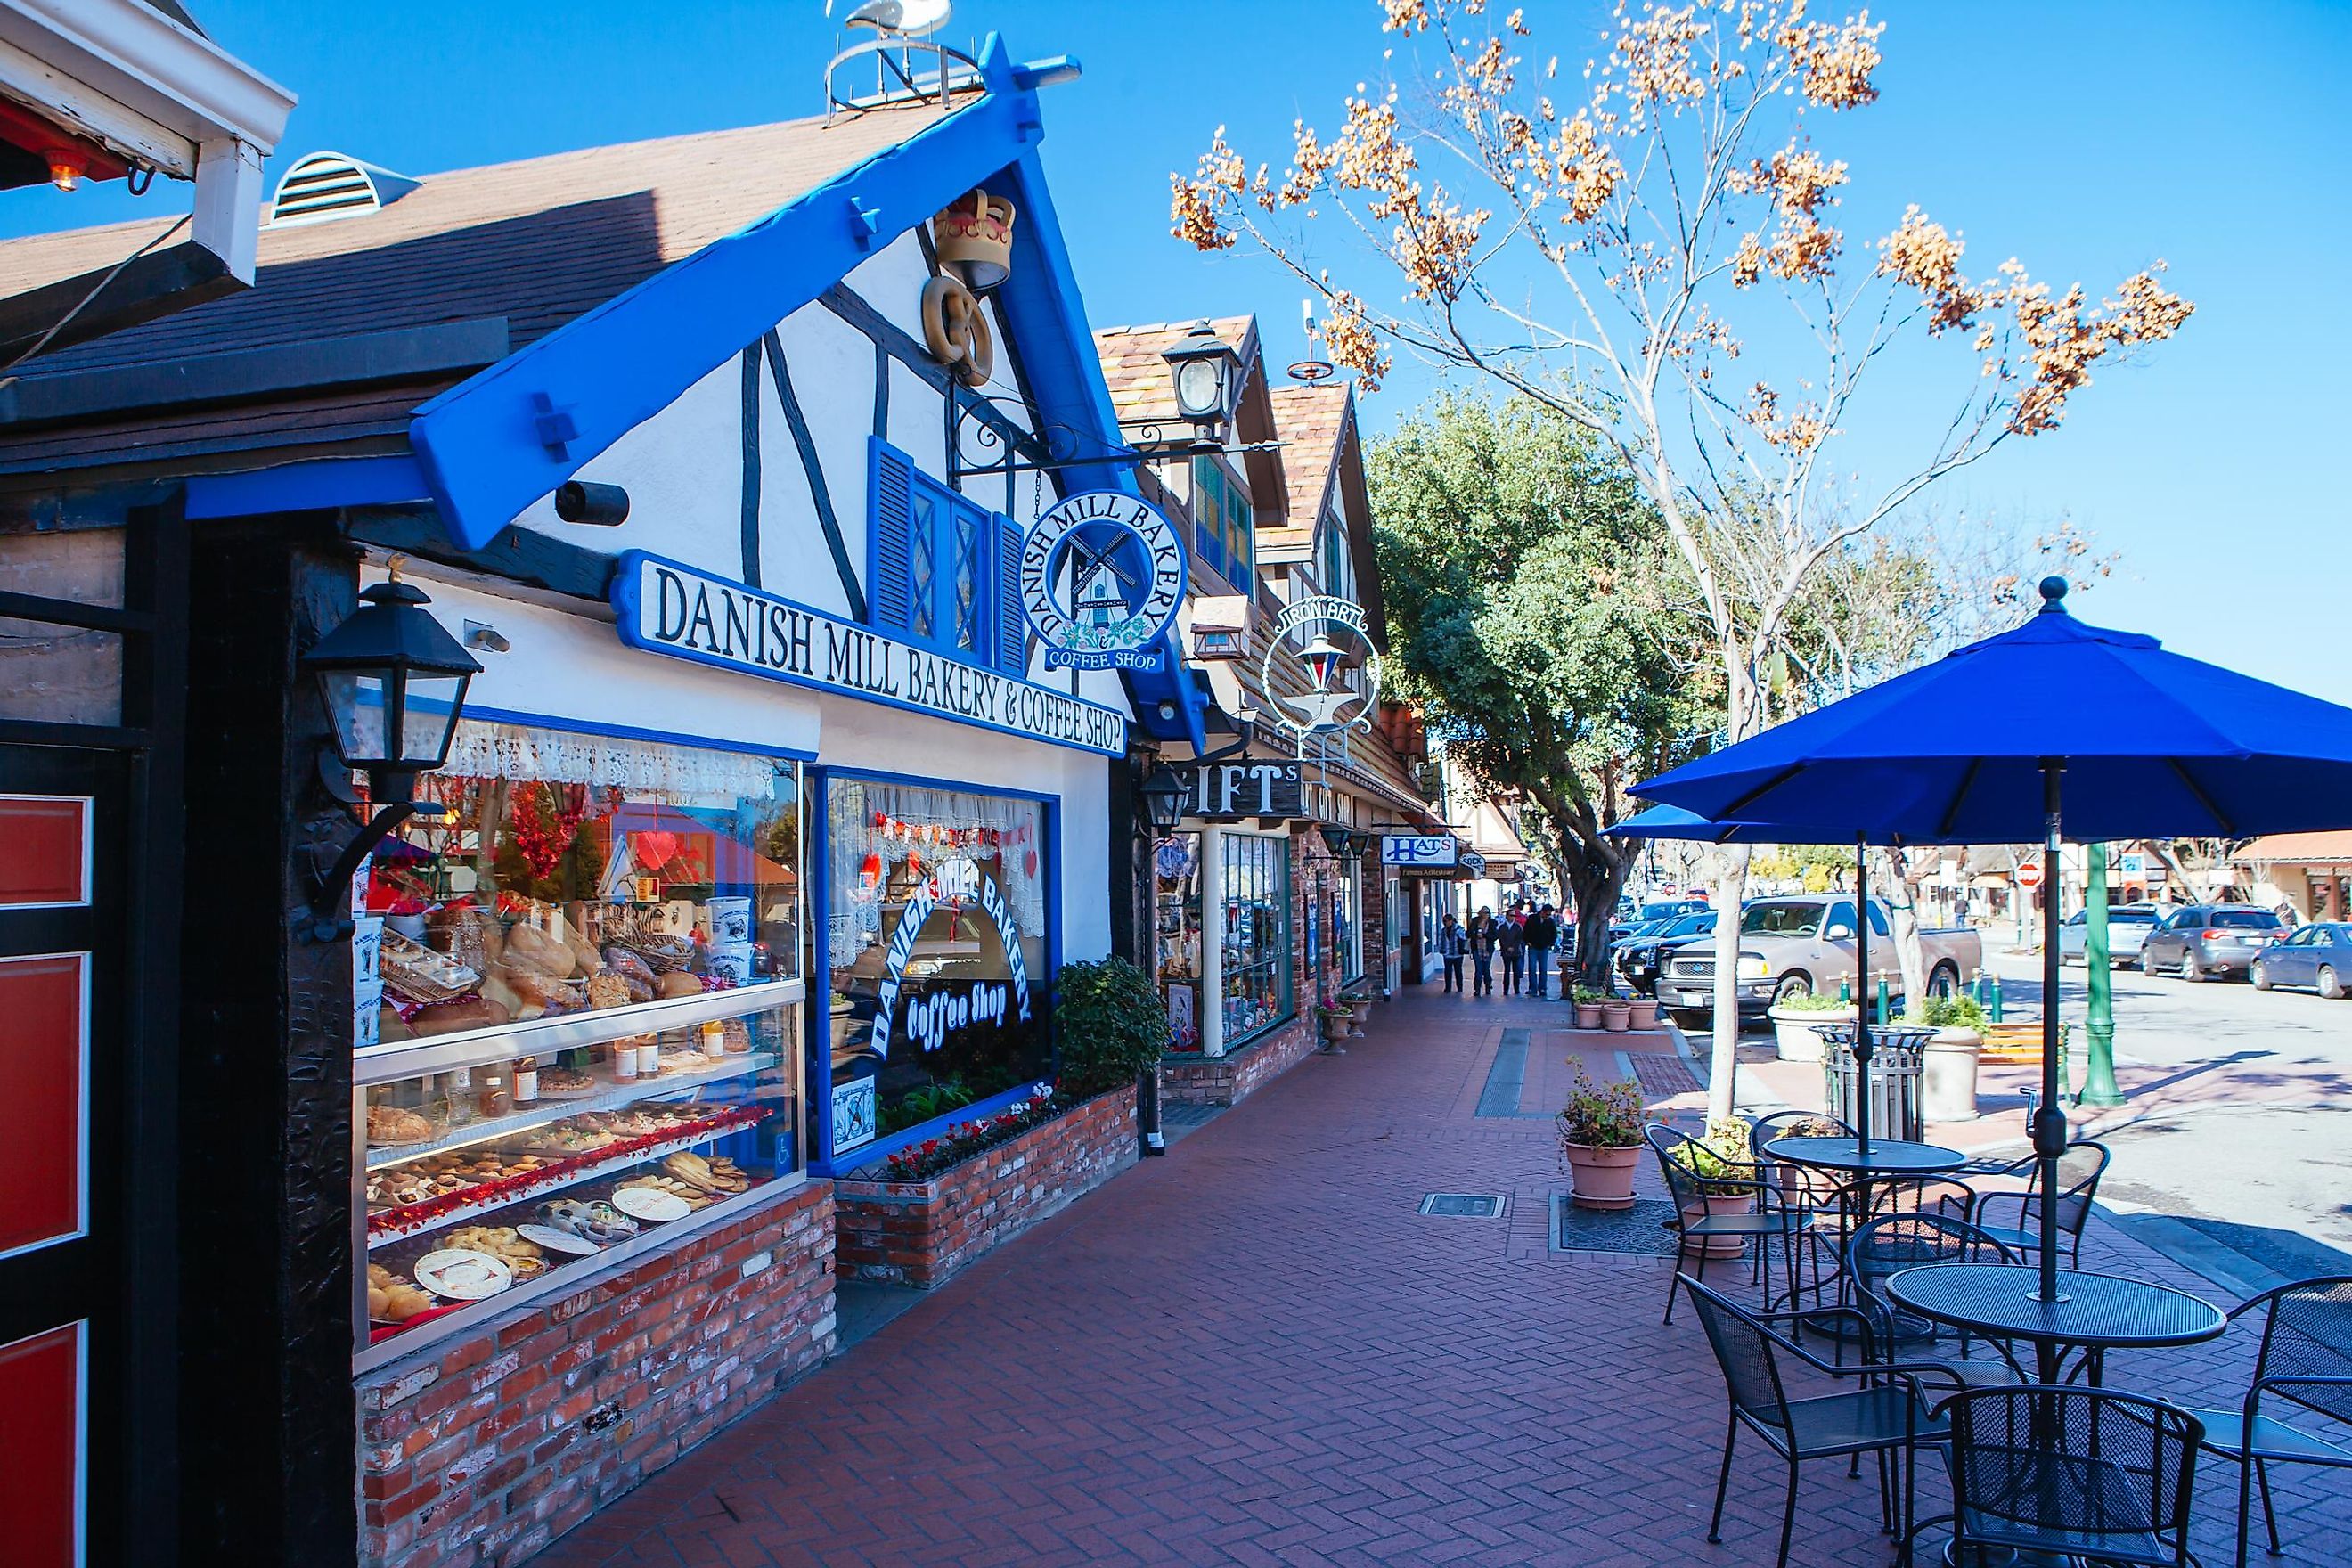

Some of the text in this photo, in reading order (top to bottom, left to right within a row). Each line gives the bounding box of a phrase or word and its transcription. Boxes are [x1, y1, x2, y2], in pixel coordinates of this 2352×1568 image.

[1022, 495, 1180, 636] DANISH MILL BAKERY
[1285, 600, 1361, 625] IRON ART
[655, 568, 1123, 752] DANISH MILL BAKERY & COFFEE SHOP
[1049, 650, 1156, 669] COFFEE SHOP
[1098, 635, 1108, 649] &
[1386, 838, 1450, 862] HATS
[870, 857, 1033, 1061] DANISH MILL BAKERY
[907, 979, 1006, 1052] Coffee Shop
